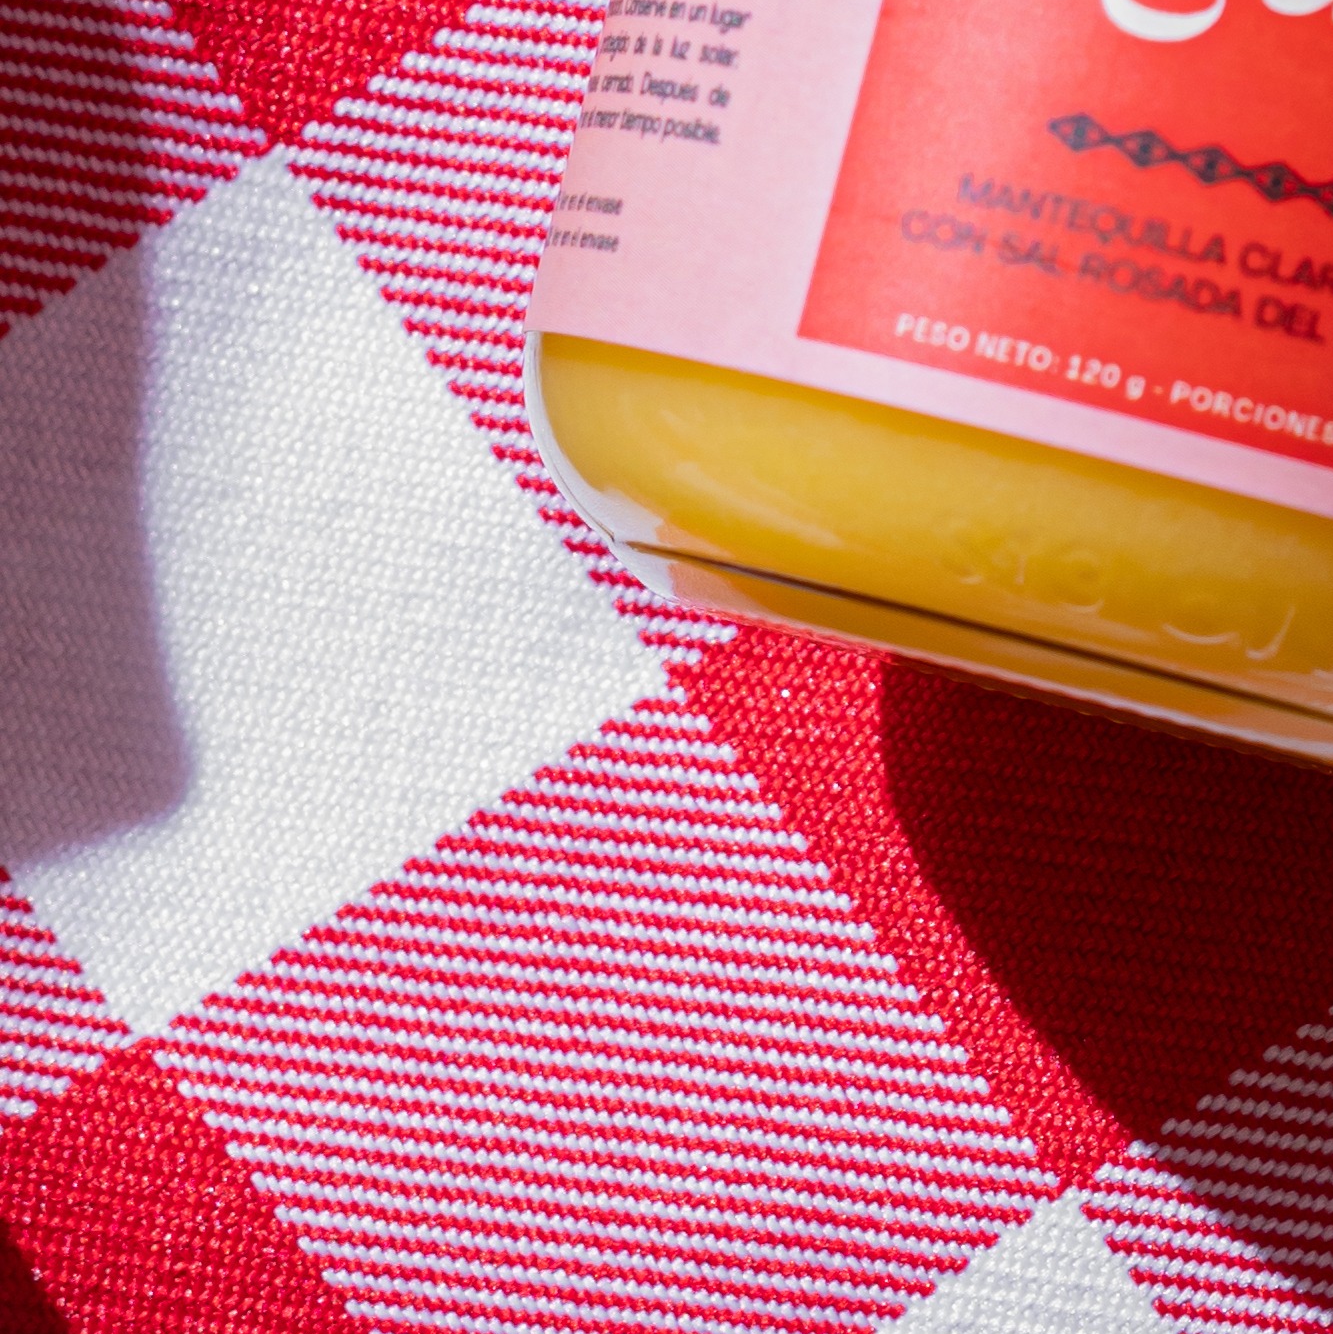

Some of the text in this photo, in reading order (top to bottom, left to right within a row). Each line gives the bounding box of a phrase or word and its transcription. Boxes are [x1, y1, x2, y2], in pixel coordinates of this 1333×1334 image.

[670, 0, 686, 19] en
[689, 3, 707, 22] un
[711, 0, 752, 34] lugar
[671, 35, 691, 60] luz
[709, 83, 731, 108] de
[957, 172, 1226, 265] MANTEQUILLA
[901, 209, 988, 256] CON
[998, 232, 1064, 277] SAL
[1079, 252, 1242, 319] ROSADA
[1254, 296, 1325, 346] DEL
[895, 312, 971, 352] PESO
[974, 331, 1060, 373] NETO:
[1066, 354, 1121, 388] 120
[1125, 375, 1146, 401] g
